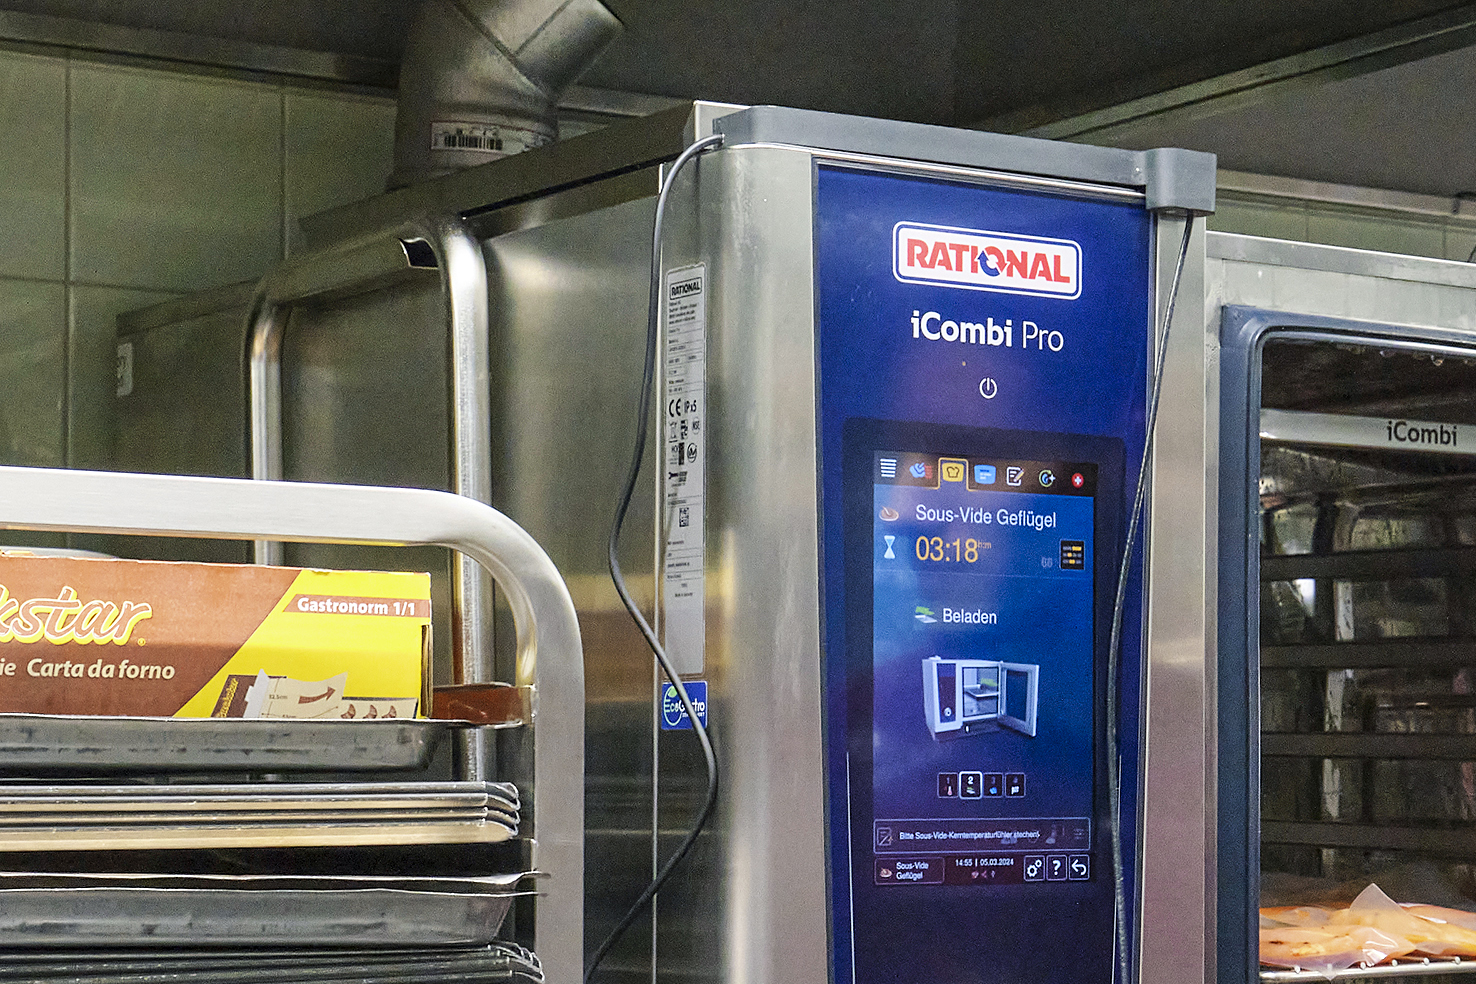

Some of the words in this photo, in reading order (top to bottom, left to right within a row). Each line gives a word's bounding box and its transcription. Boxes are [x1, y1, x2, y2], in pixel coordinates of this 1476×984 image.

[907, 238, 1071, 284] RATIONAL
[671, 281, 700, 296] RATIONAL
[910, 310, 1013, 347] iCombi
[1022, 320, 1064, 352] Pro
[1387, 420, 1457, 447] iCombi
[915, 504, 992, 524] Sous-Vide
[996, 508, 1057, 531] Geflügel
[915, 535, 979, 563] 03:18
[297, 597, 388, 616] Gastronorm
[393, 601, 415, 616] 1/1
[942, 607, 998, 625] Beladen
[26, 658, 84, 678] Carta
[87, 659, 115, 679] da
[118, 660, 176, 680] forno
[967, 776, 974, 785] 2
[896, 861, 929, 870] Sous-Vide
[896, 871, 923, 881] Geflügel
